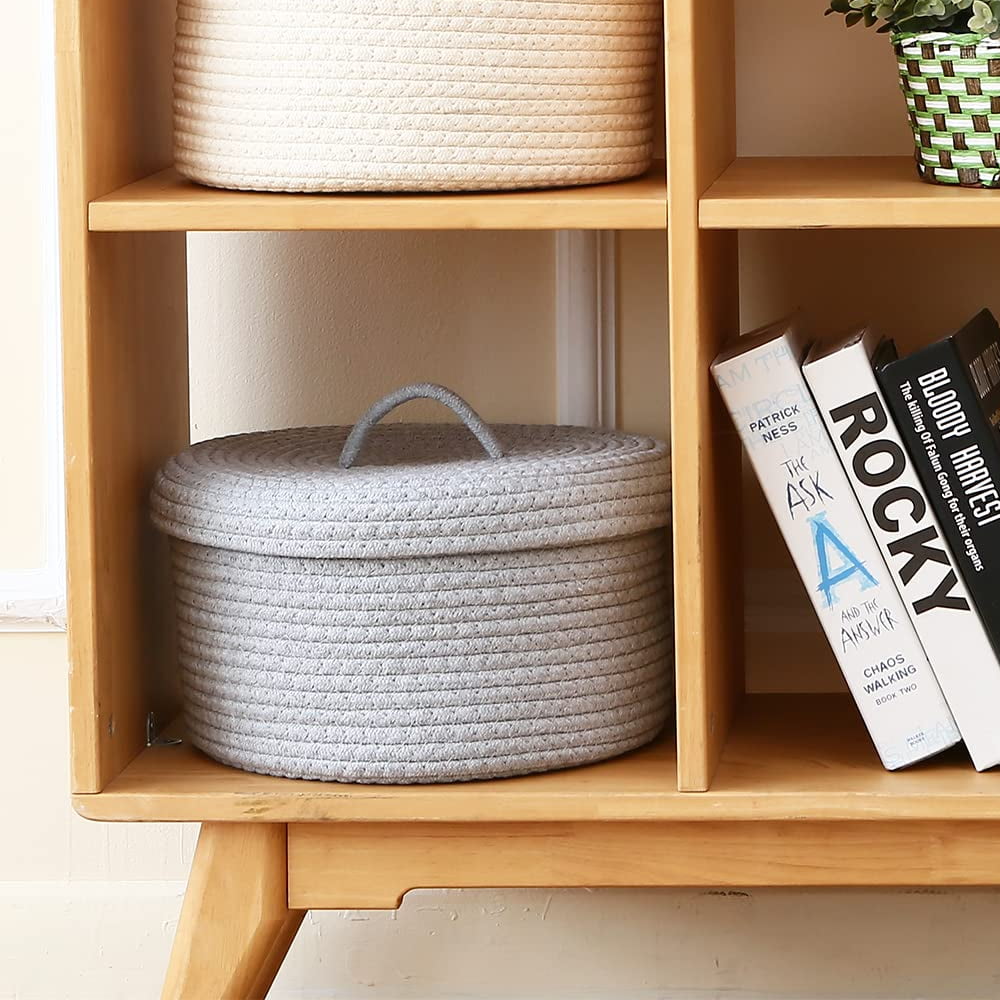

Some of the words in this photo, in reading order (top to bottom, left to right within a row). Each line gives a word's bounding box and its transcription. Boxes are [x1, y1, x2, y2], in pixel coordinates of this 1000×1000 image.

[900, 381, 913, 401] The
[918, 367, 971, 440] BLOODY
[749, 404, 801, 433] PATRICK
[907, 400, 926, 433] killing
[762, 421, 798, 443] NESS
[920, 432, 935, 445] Of
[780, 455, 810, 479] THE
[925, 443, 943, 473] Falun
[786, 471, 834, 520] ASK
[937, 472, 953, 499] Gong
[829, 392, 971, 616] ROCKY
[948, 498, 960, 513] for
[954, 513, 971, 537] their
[964, 539, 984, 572] organs
[841, 606, 860, 624] AND
[861, 598, 879, 616] THE
[841, 608, 899, 654] ANSWER
[863, 654, 905, 679] CHAOS
[863, 664, 917, 695] WALKING
[875, 692, 897, 706] BOOK
[899, 683, 918, 697] TWO
